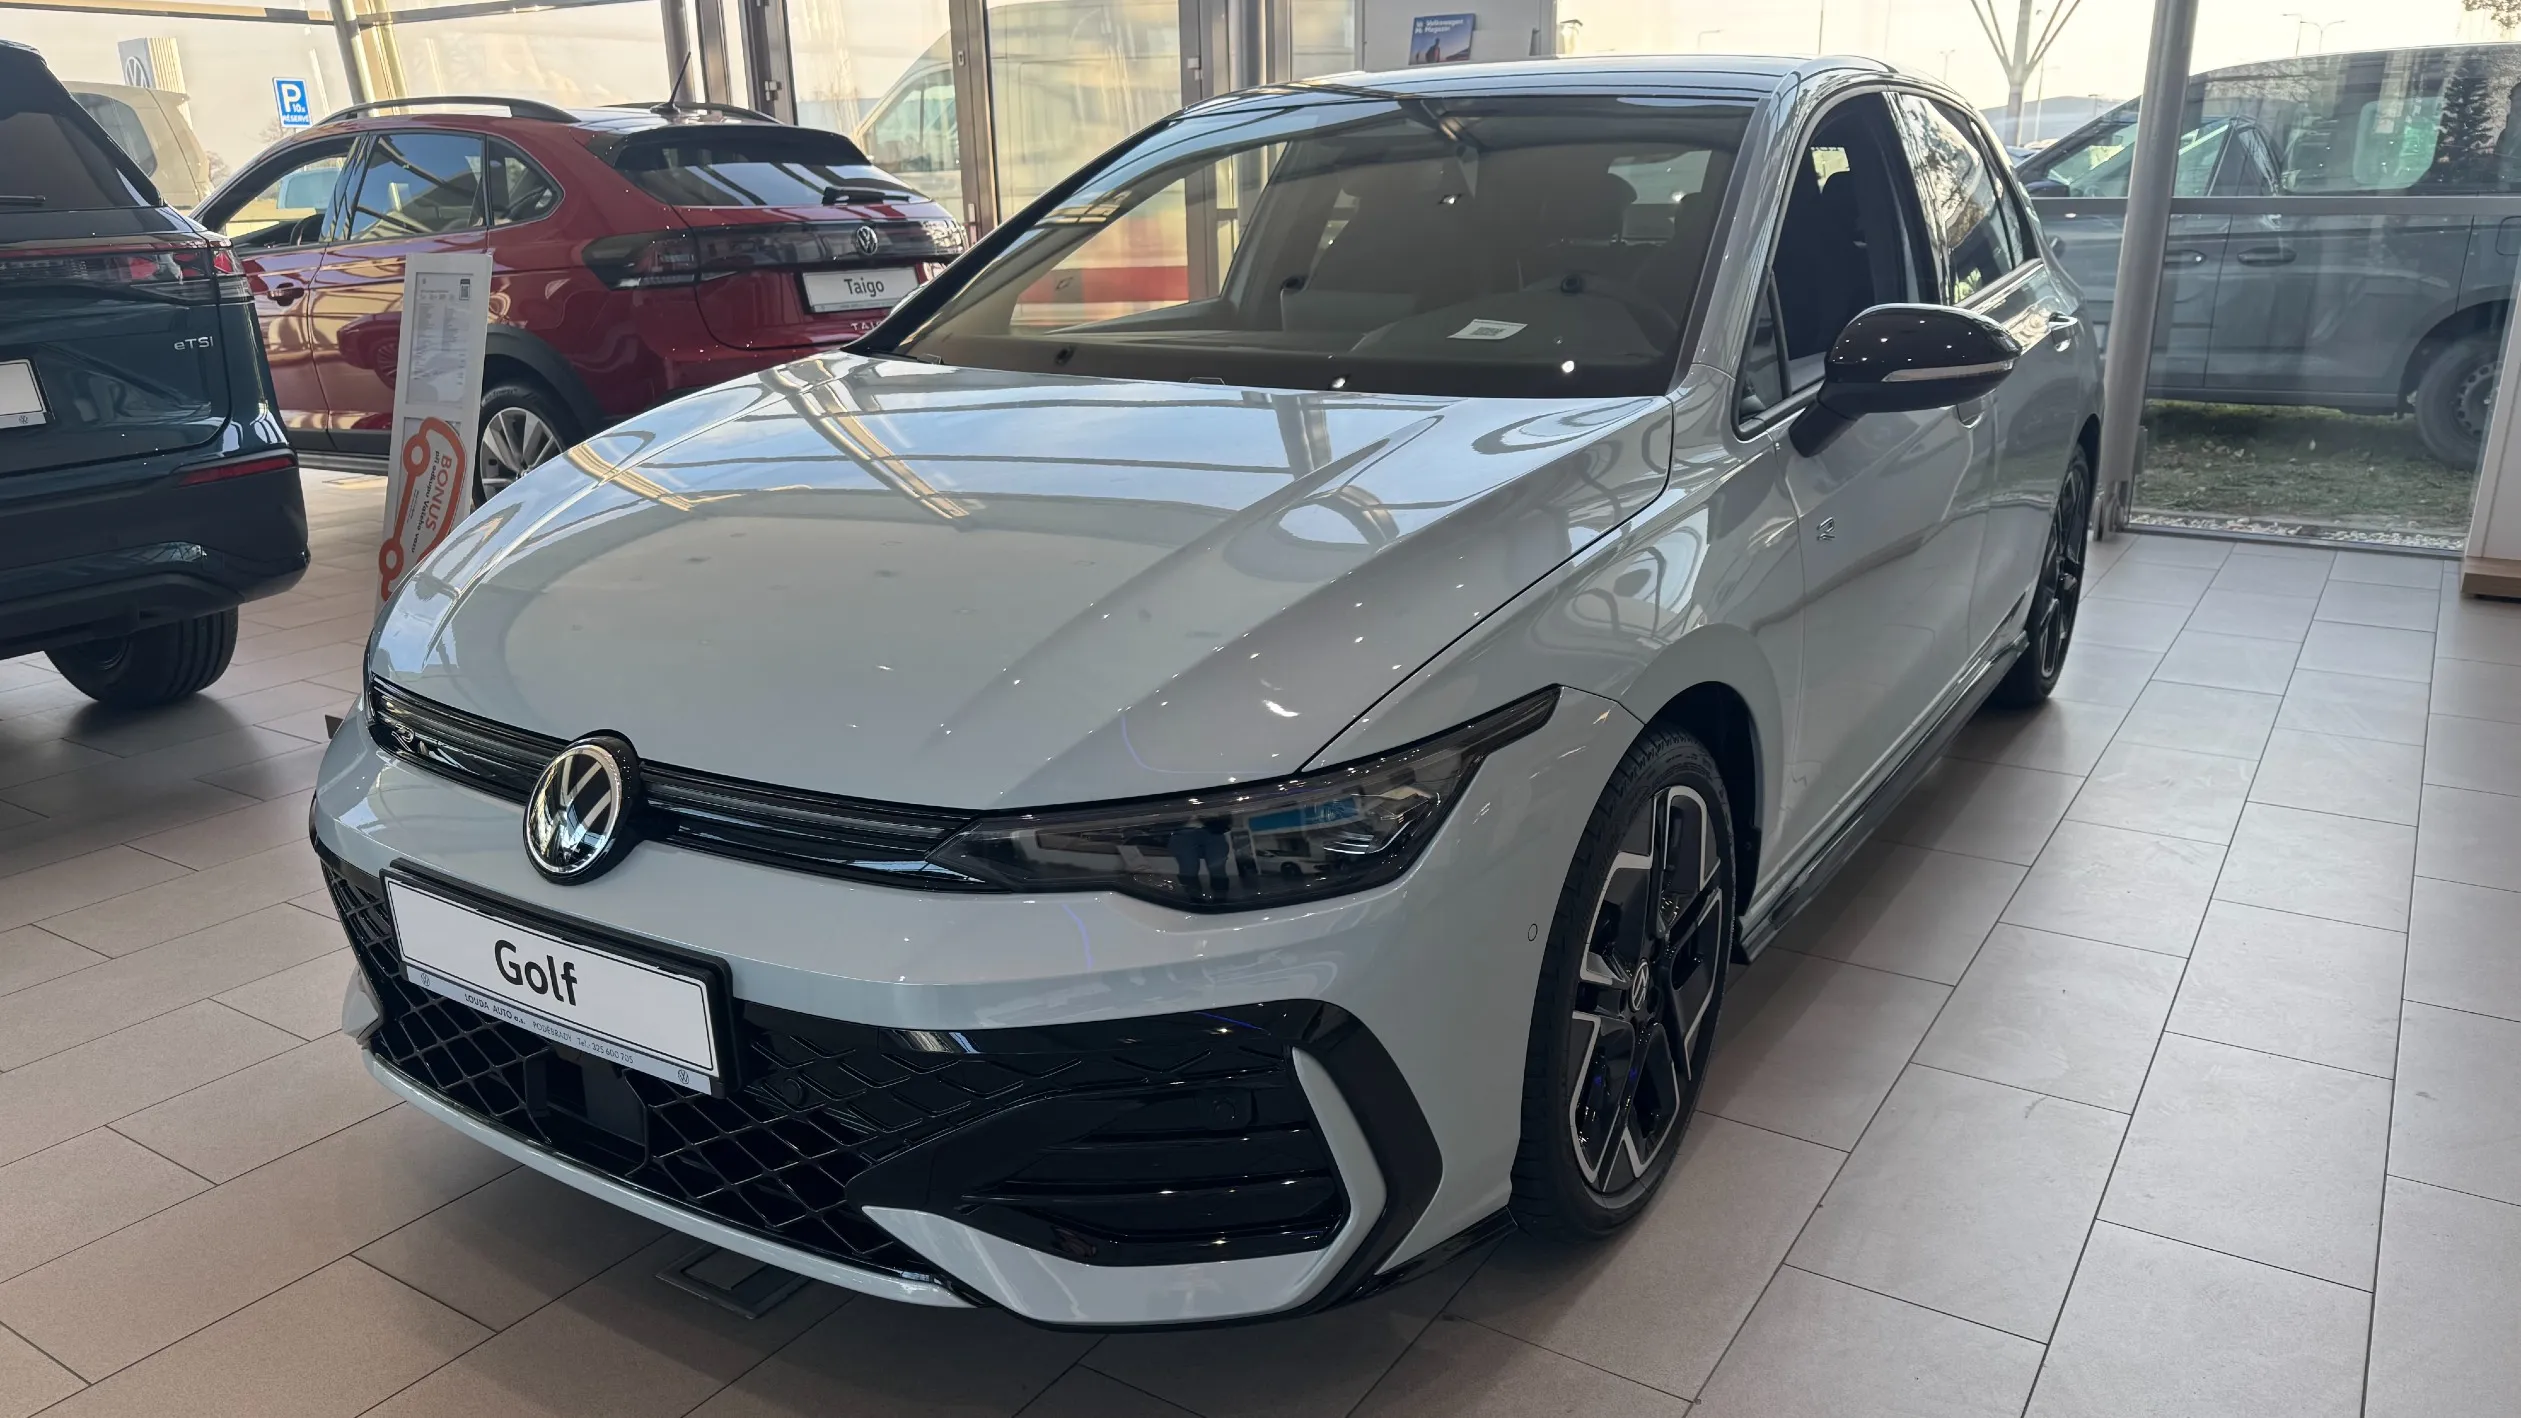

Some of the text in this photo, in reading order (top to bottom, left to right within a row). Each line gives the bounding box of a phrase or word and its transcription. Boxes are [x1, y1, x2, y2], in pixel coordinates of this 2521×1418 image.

[281, 83, 302, 112] P
[843, 277, 885, 298] Taigo
[850, 321, 885, 332] TAI
[173, 336, 214, 350] eTSI
[425, 455, 453, 532] BONUS
[494, 939, 578, 1007] Golf
[464, 993, 490, 1010] LOUDA
[492, 1005, 513, 1019] AUTO
[591, 1043, 605, 1054] 325
[605, 1048, 620, 1059] 600
